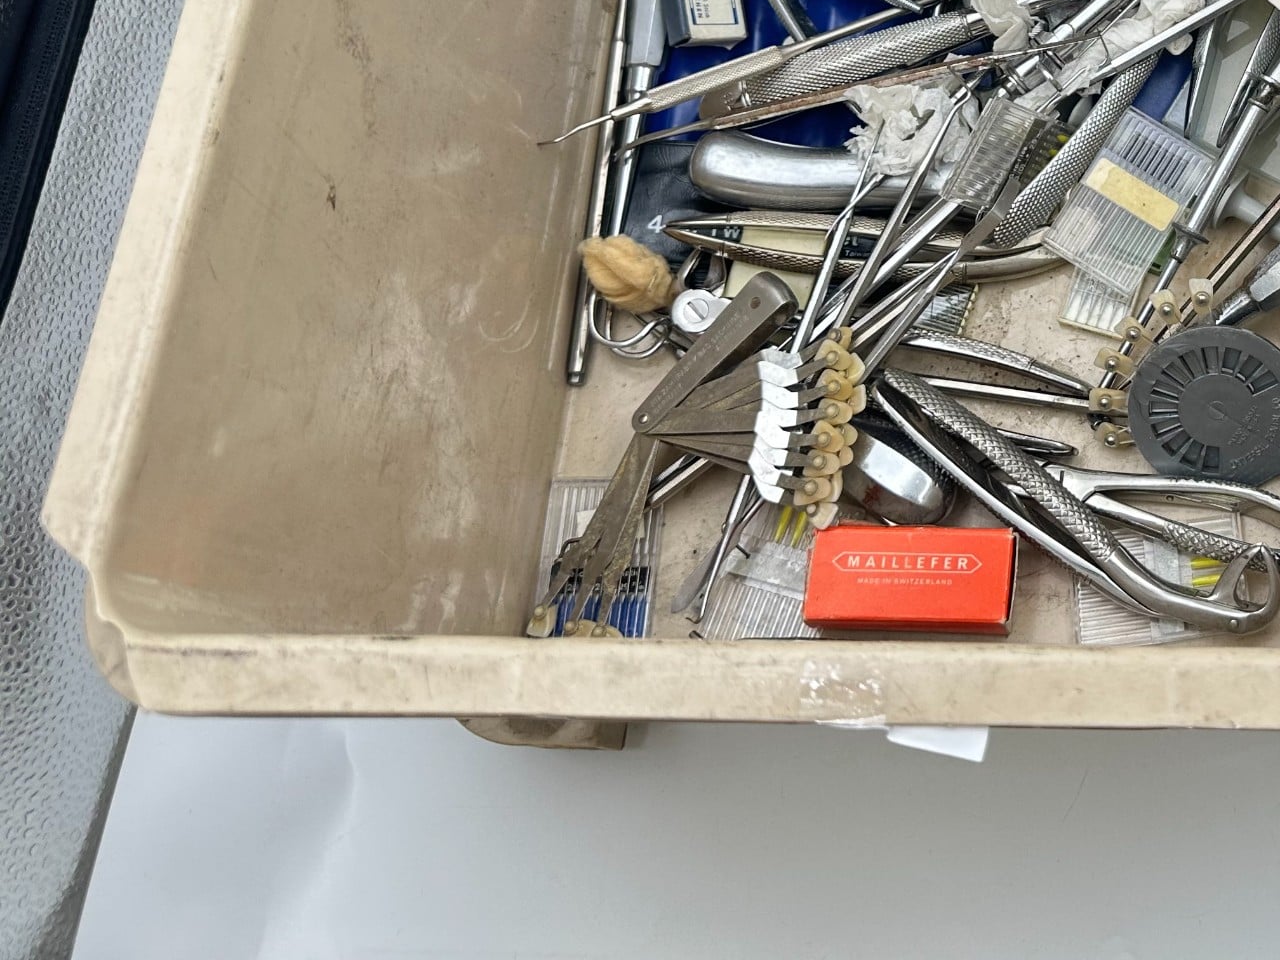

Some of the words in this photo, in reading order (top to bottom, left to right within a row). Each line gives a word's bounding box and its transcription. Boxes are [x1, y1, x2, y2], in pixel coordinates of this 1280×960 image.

[847, 555, 969, 570] MAILLEFER
[857, 577, 880, 585] MADE
[894, 578, 953, 586] SWITZERLAND
